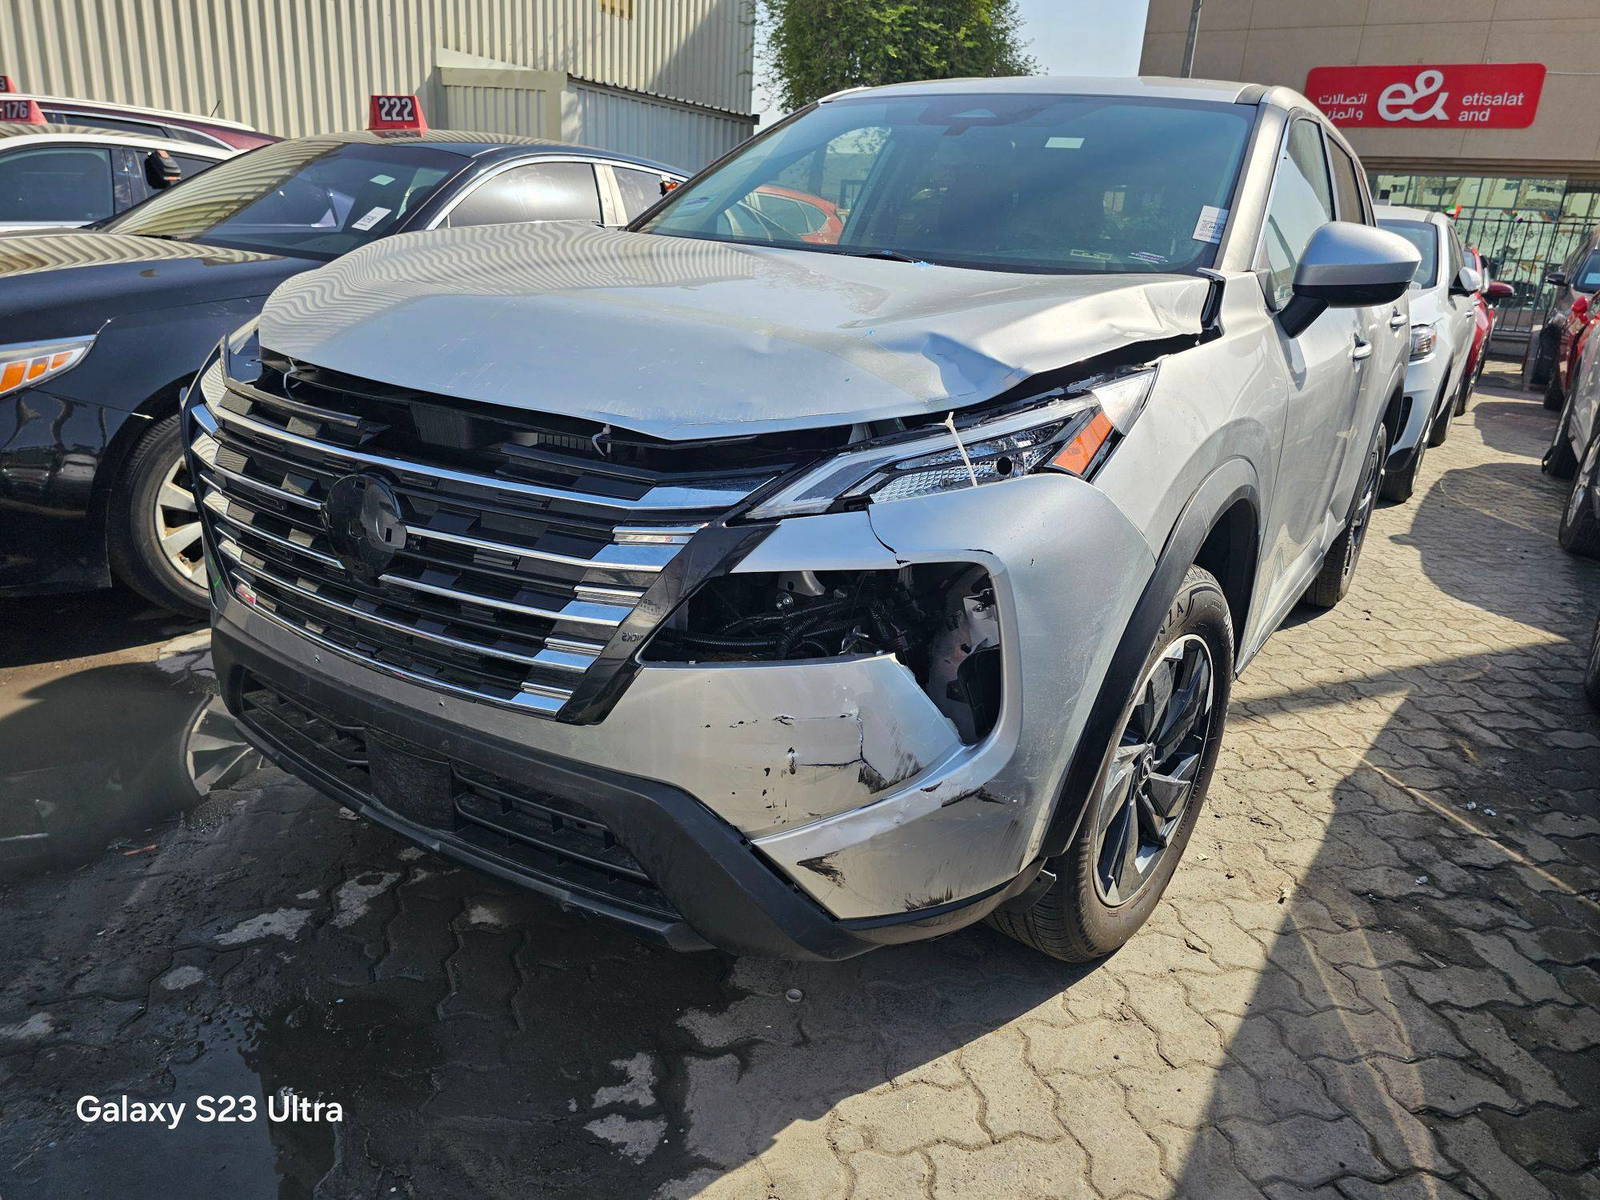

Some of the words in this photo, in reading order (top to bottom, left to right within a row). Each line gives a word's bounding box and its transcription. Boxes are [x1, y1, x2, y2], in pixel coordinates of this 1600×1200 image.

[1318, 93, 1368, 105] اتصالات
[1462, 91, 1525, 107] etisalat
[5, 101, 29, 120] 176
[378, 97, 414, 121] 222
[1458, 108, 1490, 122] and
